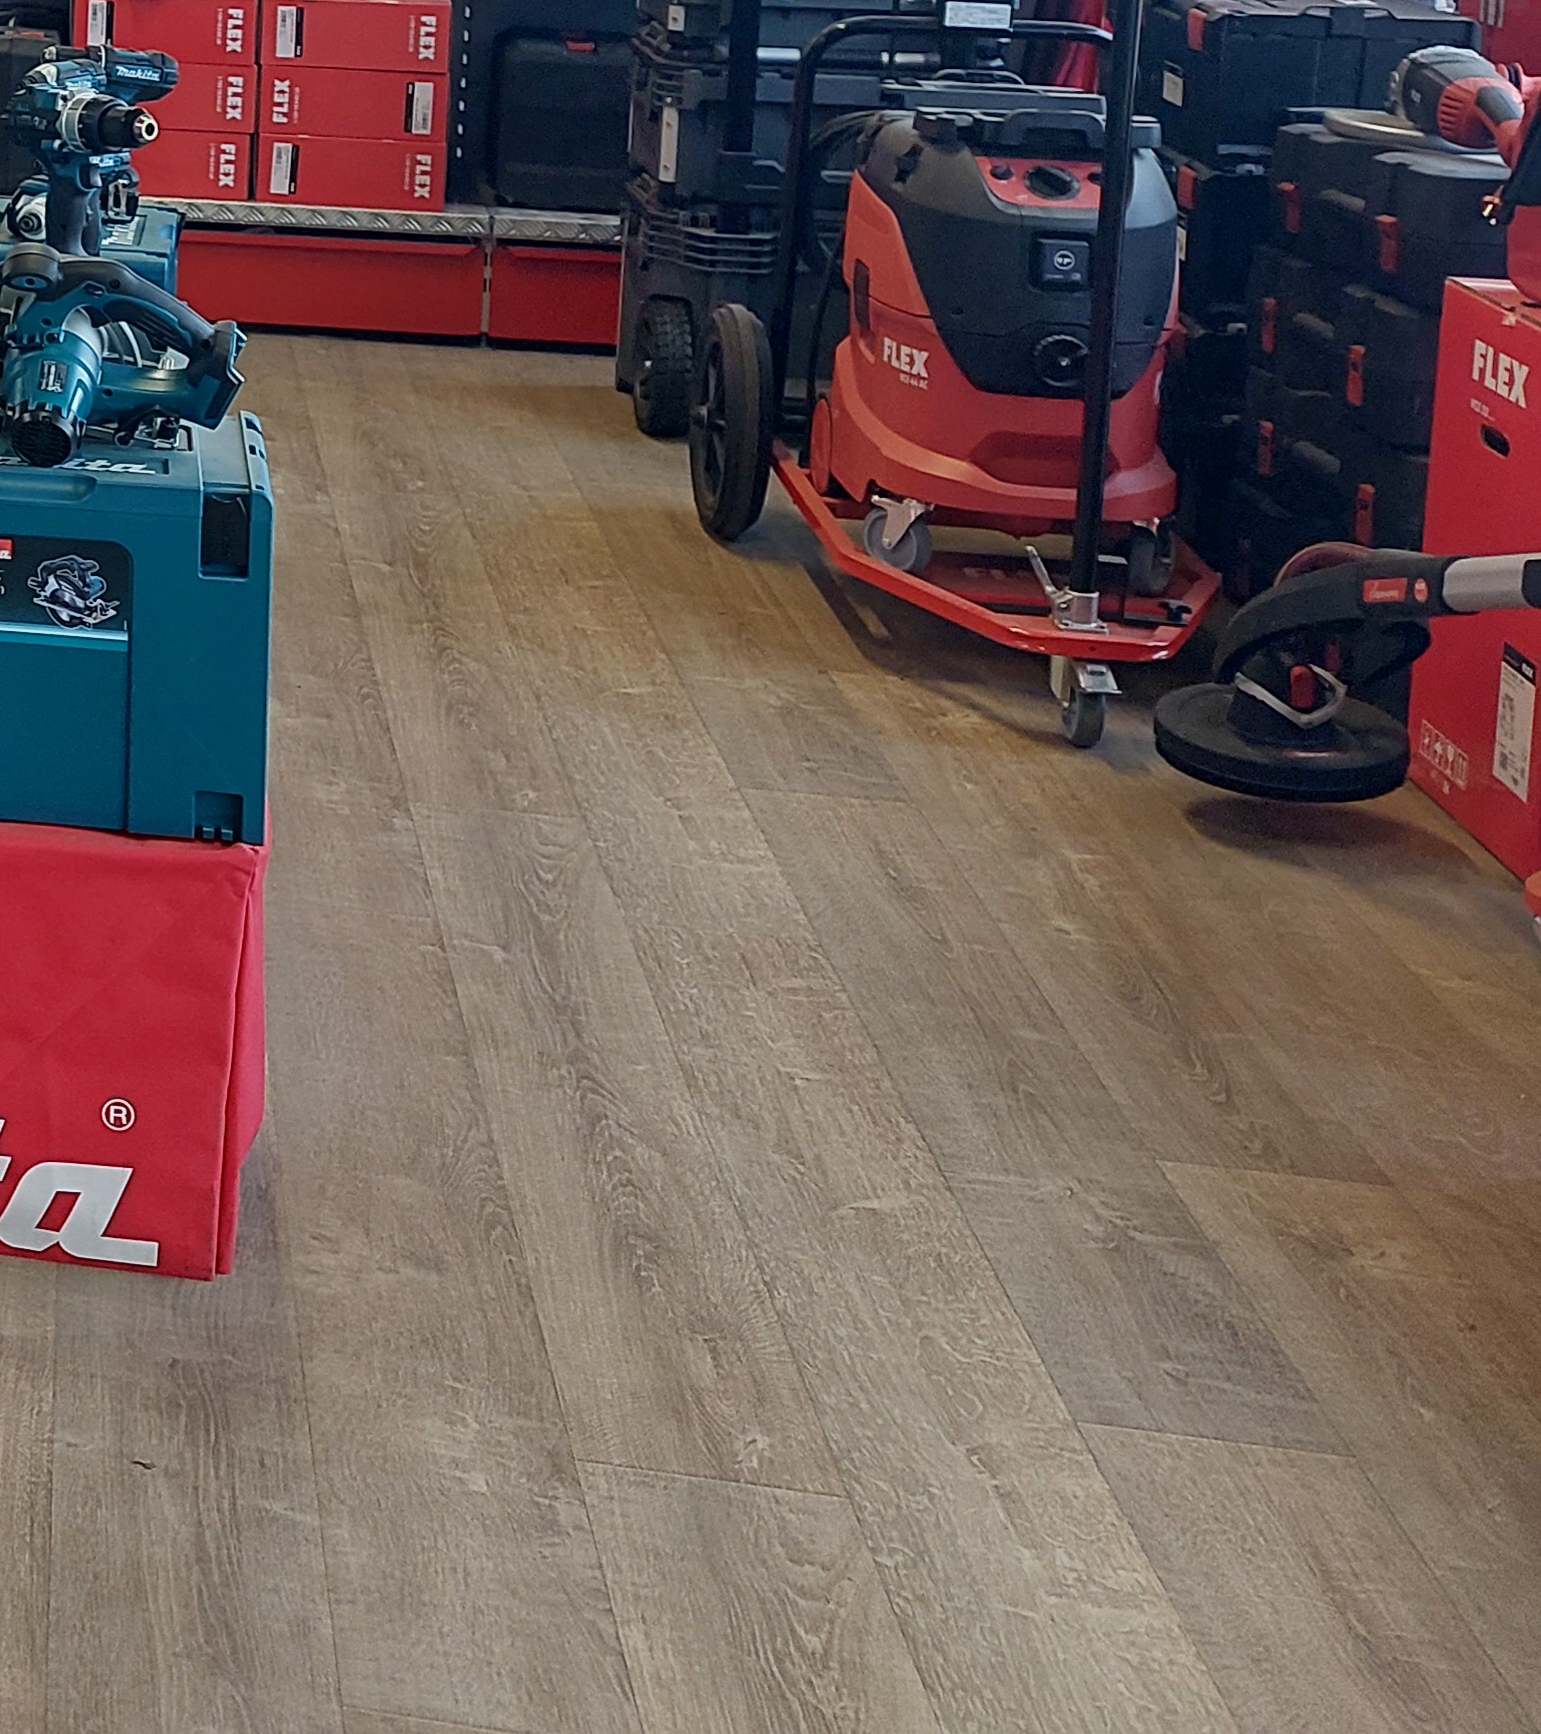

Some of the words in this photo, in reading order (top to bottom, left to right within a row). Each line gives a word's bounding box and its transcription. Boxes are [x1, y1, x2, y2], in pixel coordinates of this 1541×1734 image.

[225, 8, 243, 53] FLEX
[418, 14, 436, 61] FLEX
[117, 67, 161, 81] Makita
[225, 76, 243, 122] FLEX
[272, 77, 291, 124] FLEX
[220, 143, 236, 188] FLEX
[414, 154, 432, 199] FLEX
[883, 337, 929, 378] FLEX
[1471, 339, 1529, 409] FLEX
